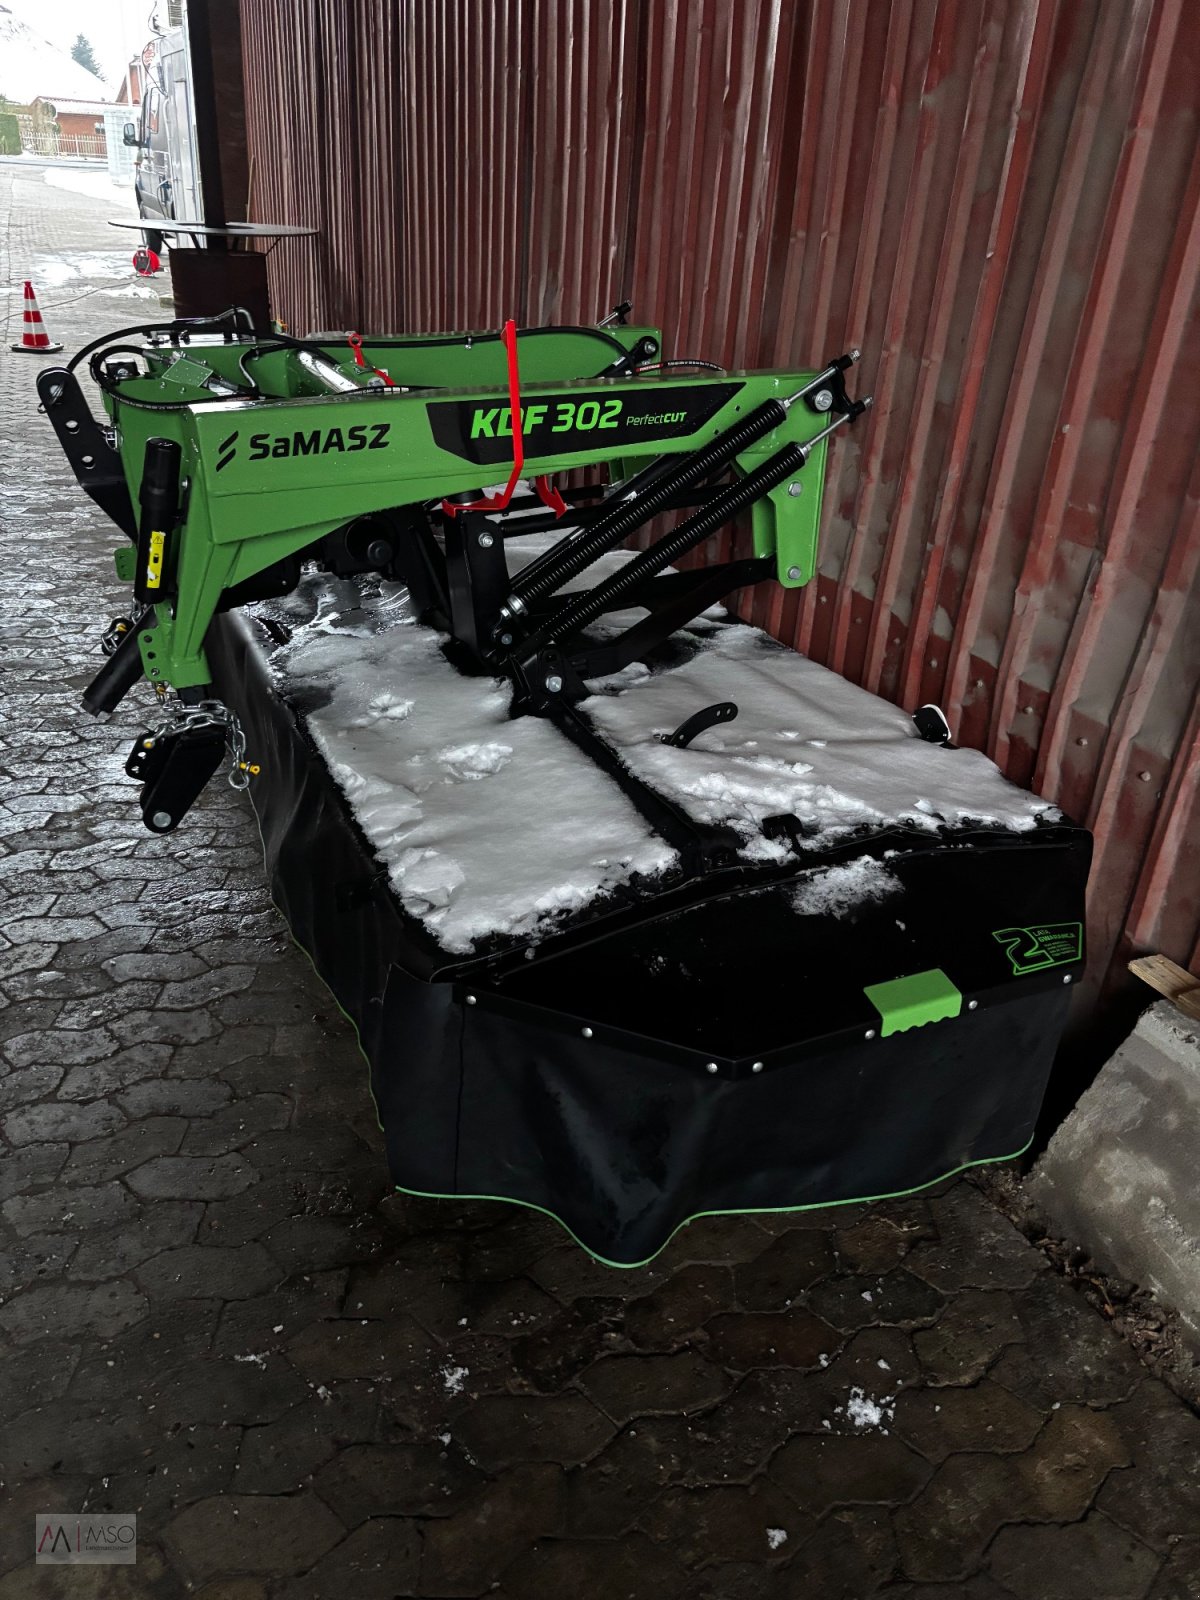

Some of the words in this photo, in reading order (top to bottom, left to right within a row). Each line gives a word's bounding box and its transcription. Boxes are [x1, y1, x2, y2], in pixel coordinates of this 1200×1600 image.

[470, 405, 548, 439] KDF
[551, 400, 623, 433] 302
[248, 423, 391, 460] SaMASZ
